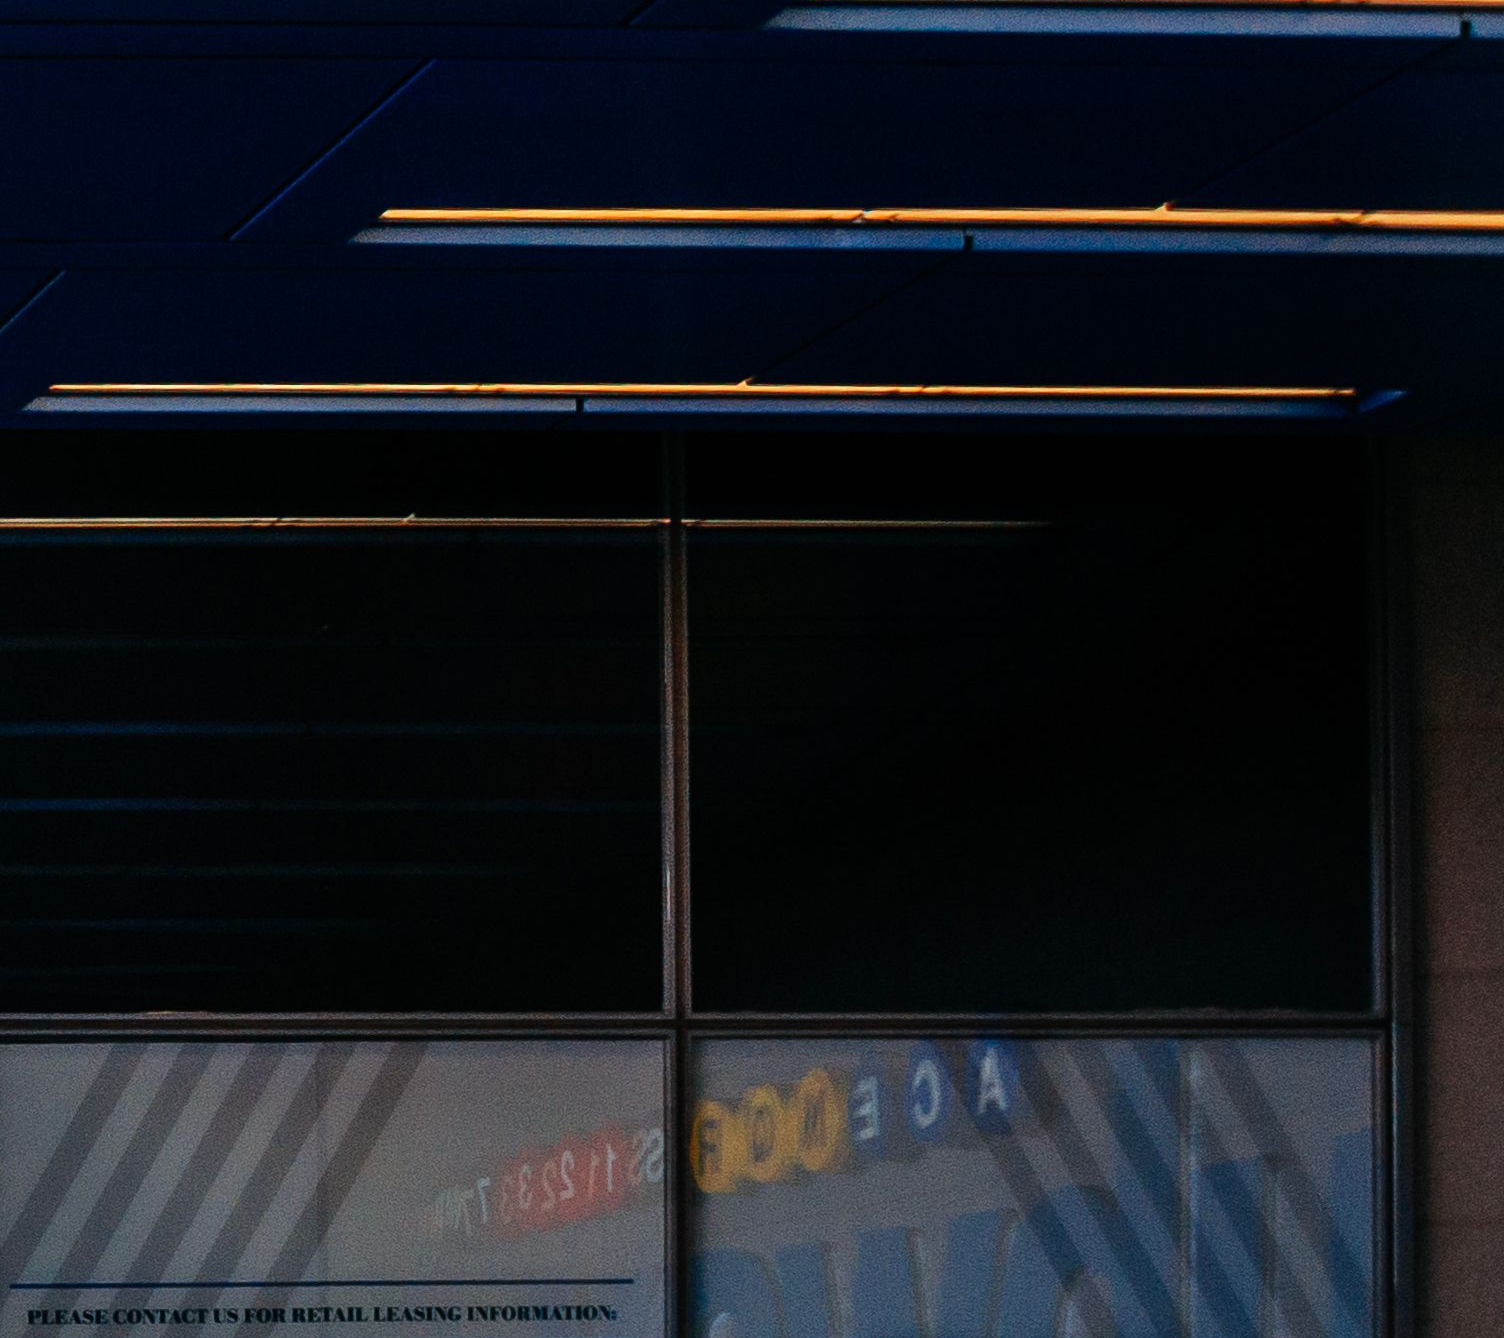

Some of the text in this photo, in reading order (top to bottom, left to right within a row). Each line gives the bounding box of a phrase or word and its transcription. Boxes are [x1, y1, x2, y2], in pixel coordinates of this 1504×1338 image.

[27, 1304, 618, 1326] PLEASE CONTACT US FOR RETAIL LEASING INFORMATION:
